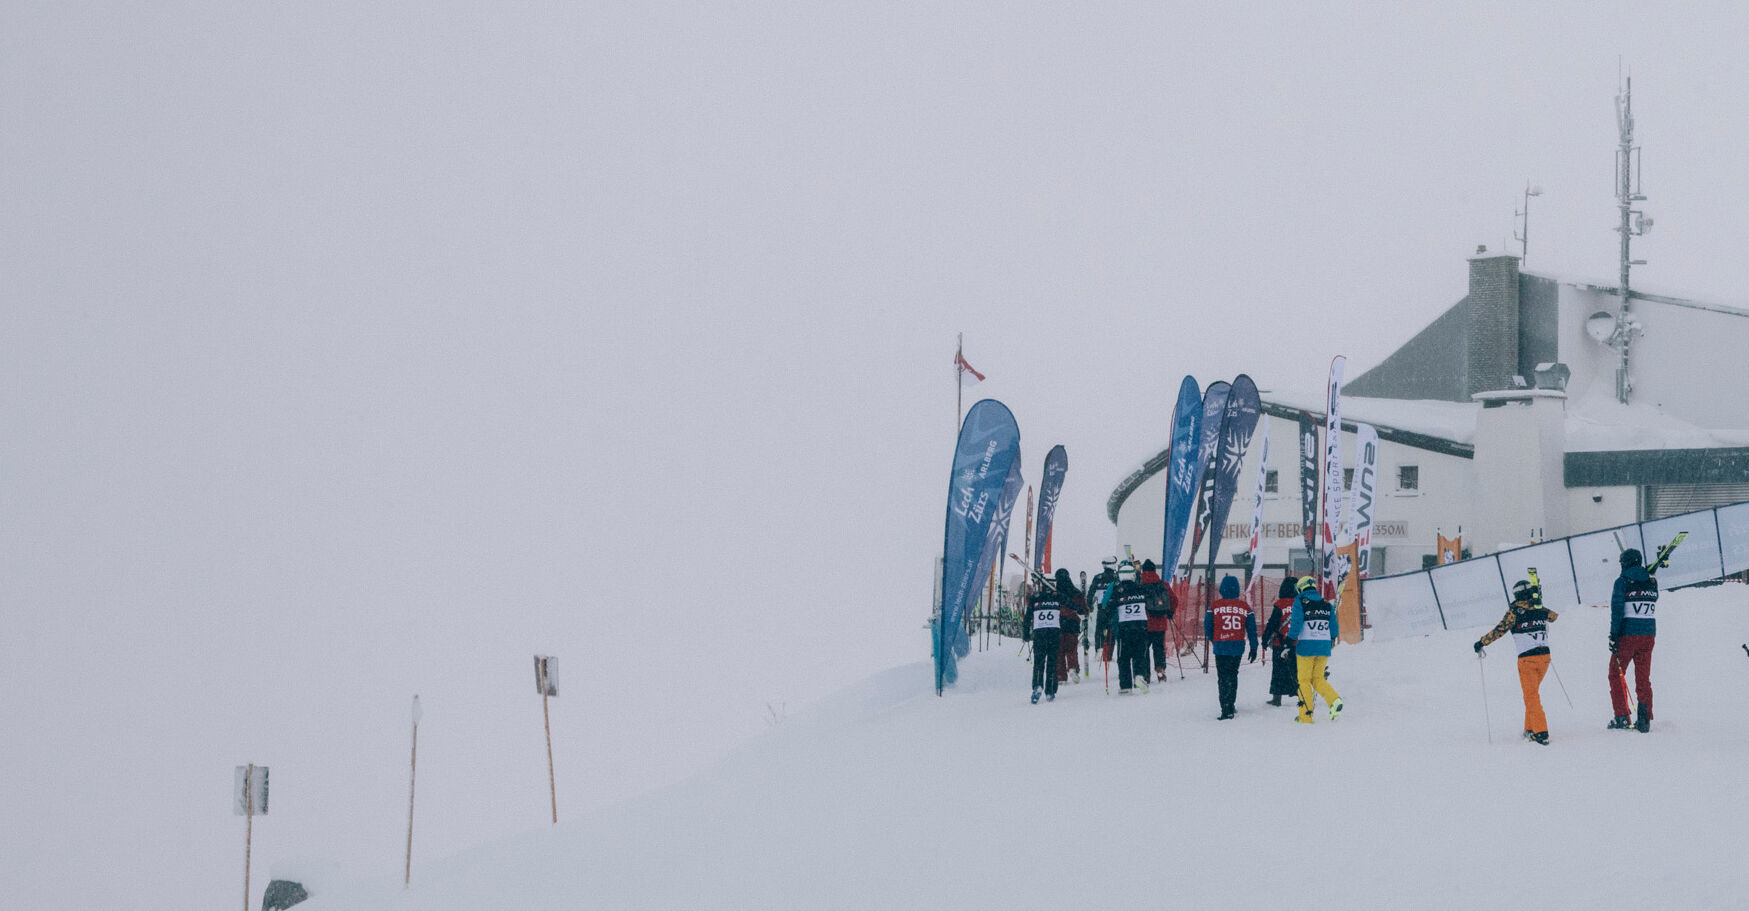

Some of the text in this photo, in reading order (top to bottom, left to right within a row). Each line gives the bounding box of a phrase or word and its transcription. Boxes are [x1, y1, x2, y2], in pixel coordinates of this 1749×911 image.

[979, 440, 997, 479] ARLBERG
[955, 487, 975, 517] Lech
[967, 491, 989, 524] Zürs
[1038, 611, 1055, 621] 66
[1125, 604, 1141, 614] 52
[1221, 615, 1242, 630] 36
